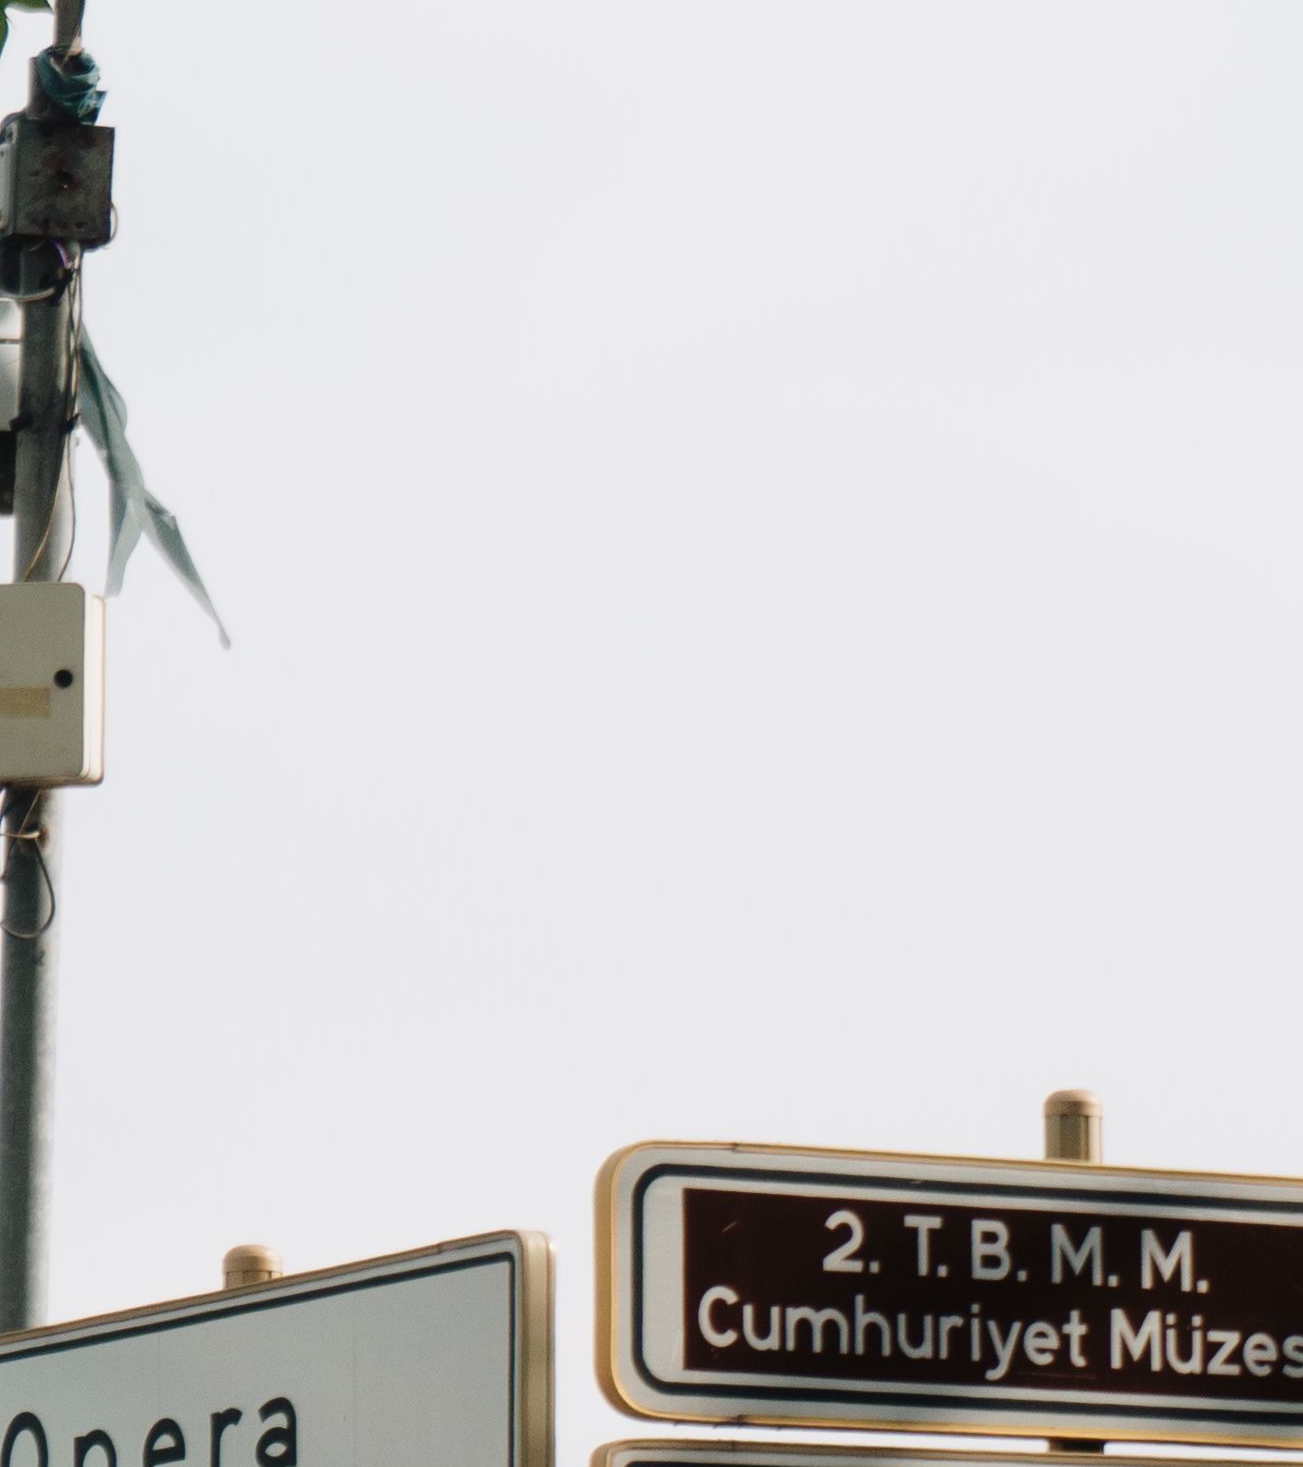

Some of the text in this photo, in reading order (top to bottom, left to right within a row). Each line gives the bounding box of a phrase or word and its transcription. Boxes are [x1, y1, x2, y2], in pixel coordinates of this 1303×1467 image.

[823, 1210, 1208, 1293] 2. T. B. M. M.
[696, 1284, 1088, 1382] Cumhuriyet
